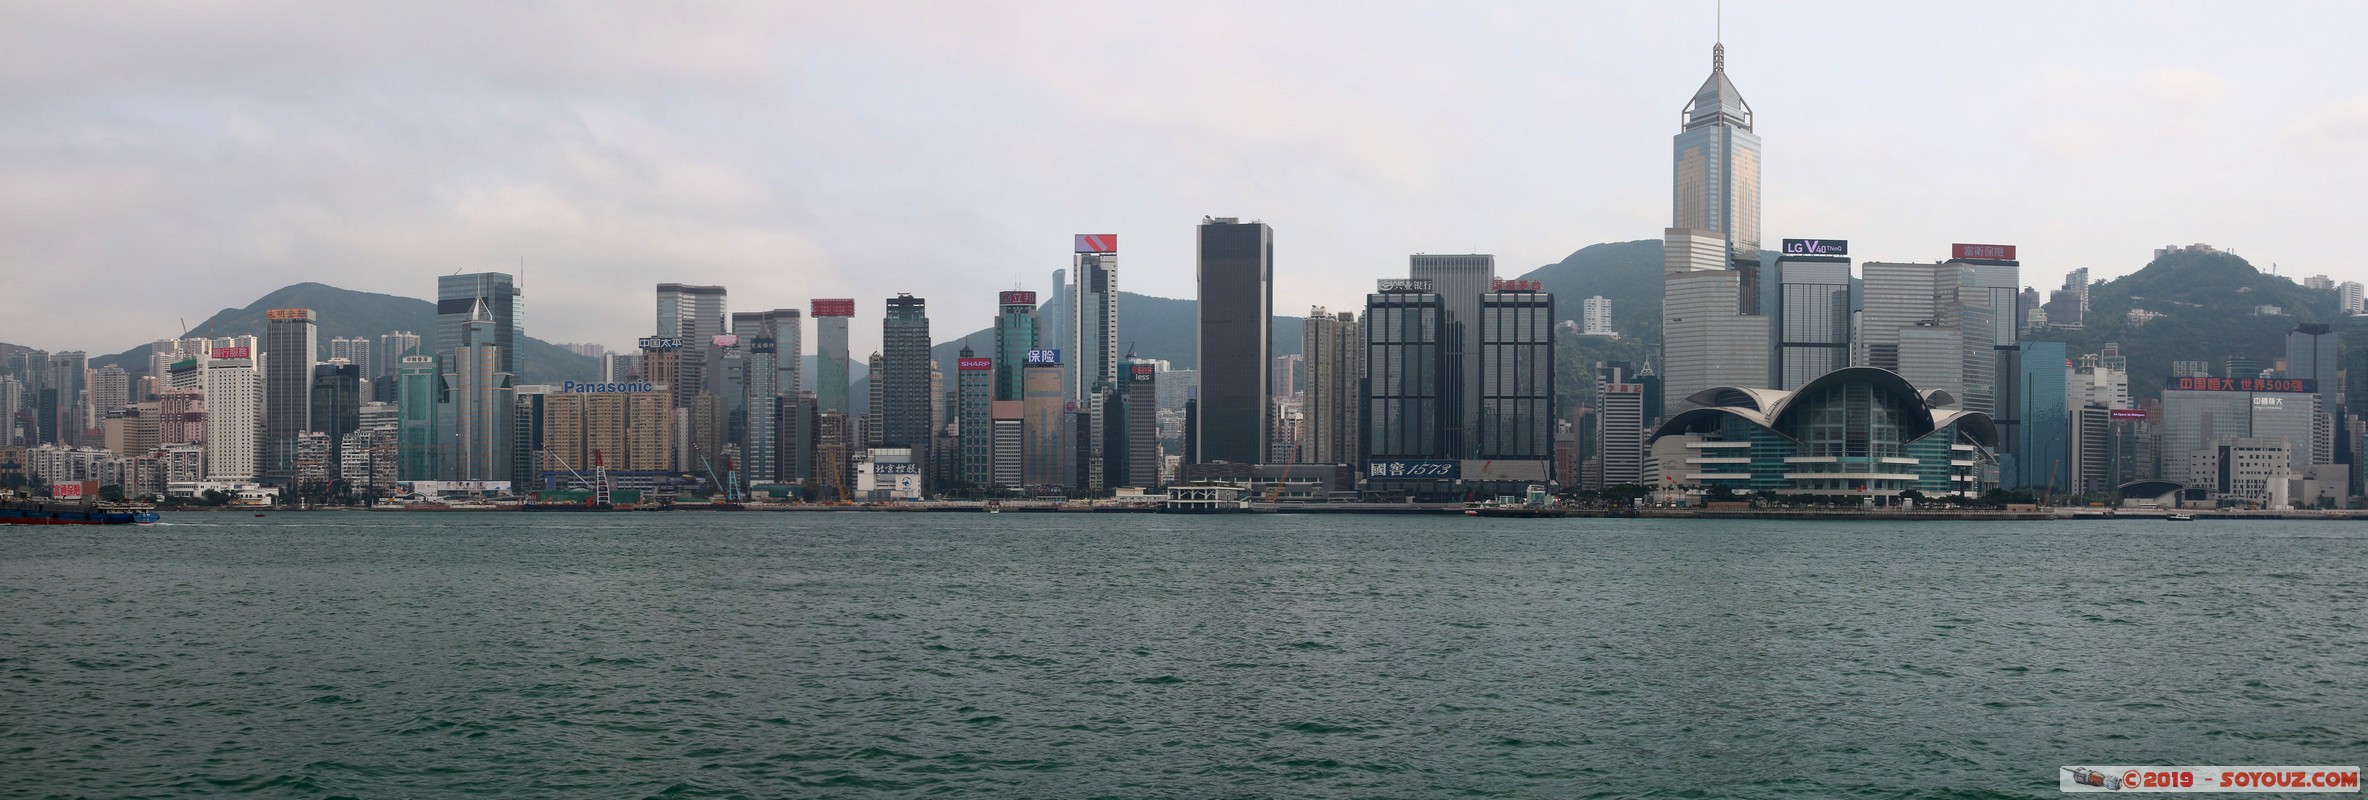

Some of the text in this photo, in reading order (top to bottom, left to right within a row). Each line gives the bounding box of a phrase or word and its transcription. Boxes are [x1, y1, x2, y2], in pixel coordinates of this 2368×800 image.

[1788, 243, 1803, 253] LG
[1804, 240, 1826, 253] V40
[1964, 246, 2004, 256] 富衛保險
[1394, 281, 1432, 290] 兴业银行
[1013, 293, 1034, 303] 立邦
[639, 338, 682, 348] 中国太平
[212, 347, 249, 358] 銀行服務
[1028, 350, 1055, 363] 保险
[564, 380, 653, 394] Panasonic
[2180, 378, 2304, 392] 中国恒大 世界500强
[876, 464, 918, 474] 北京控股
[1371, 462, 1452, 476] 國窖 1573
